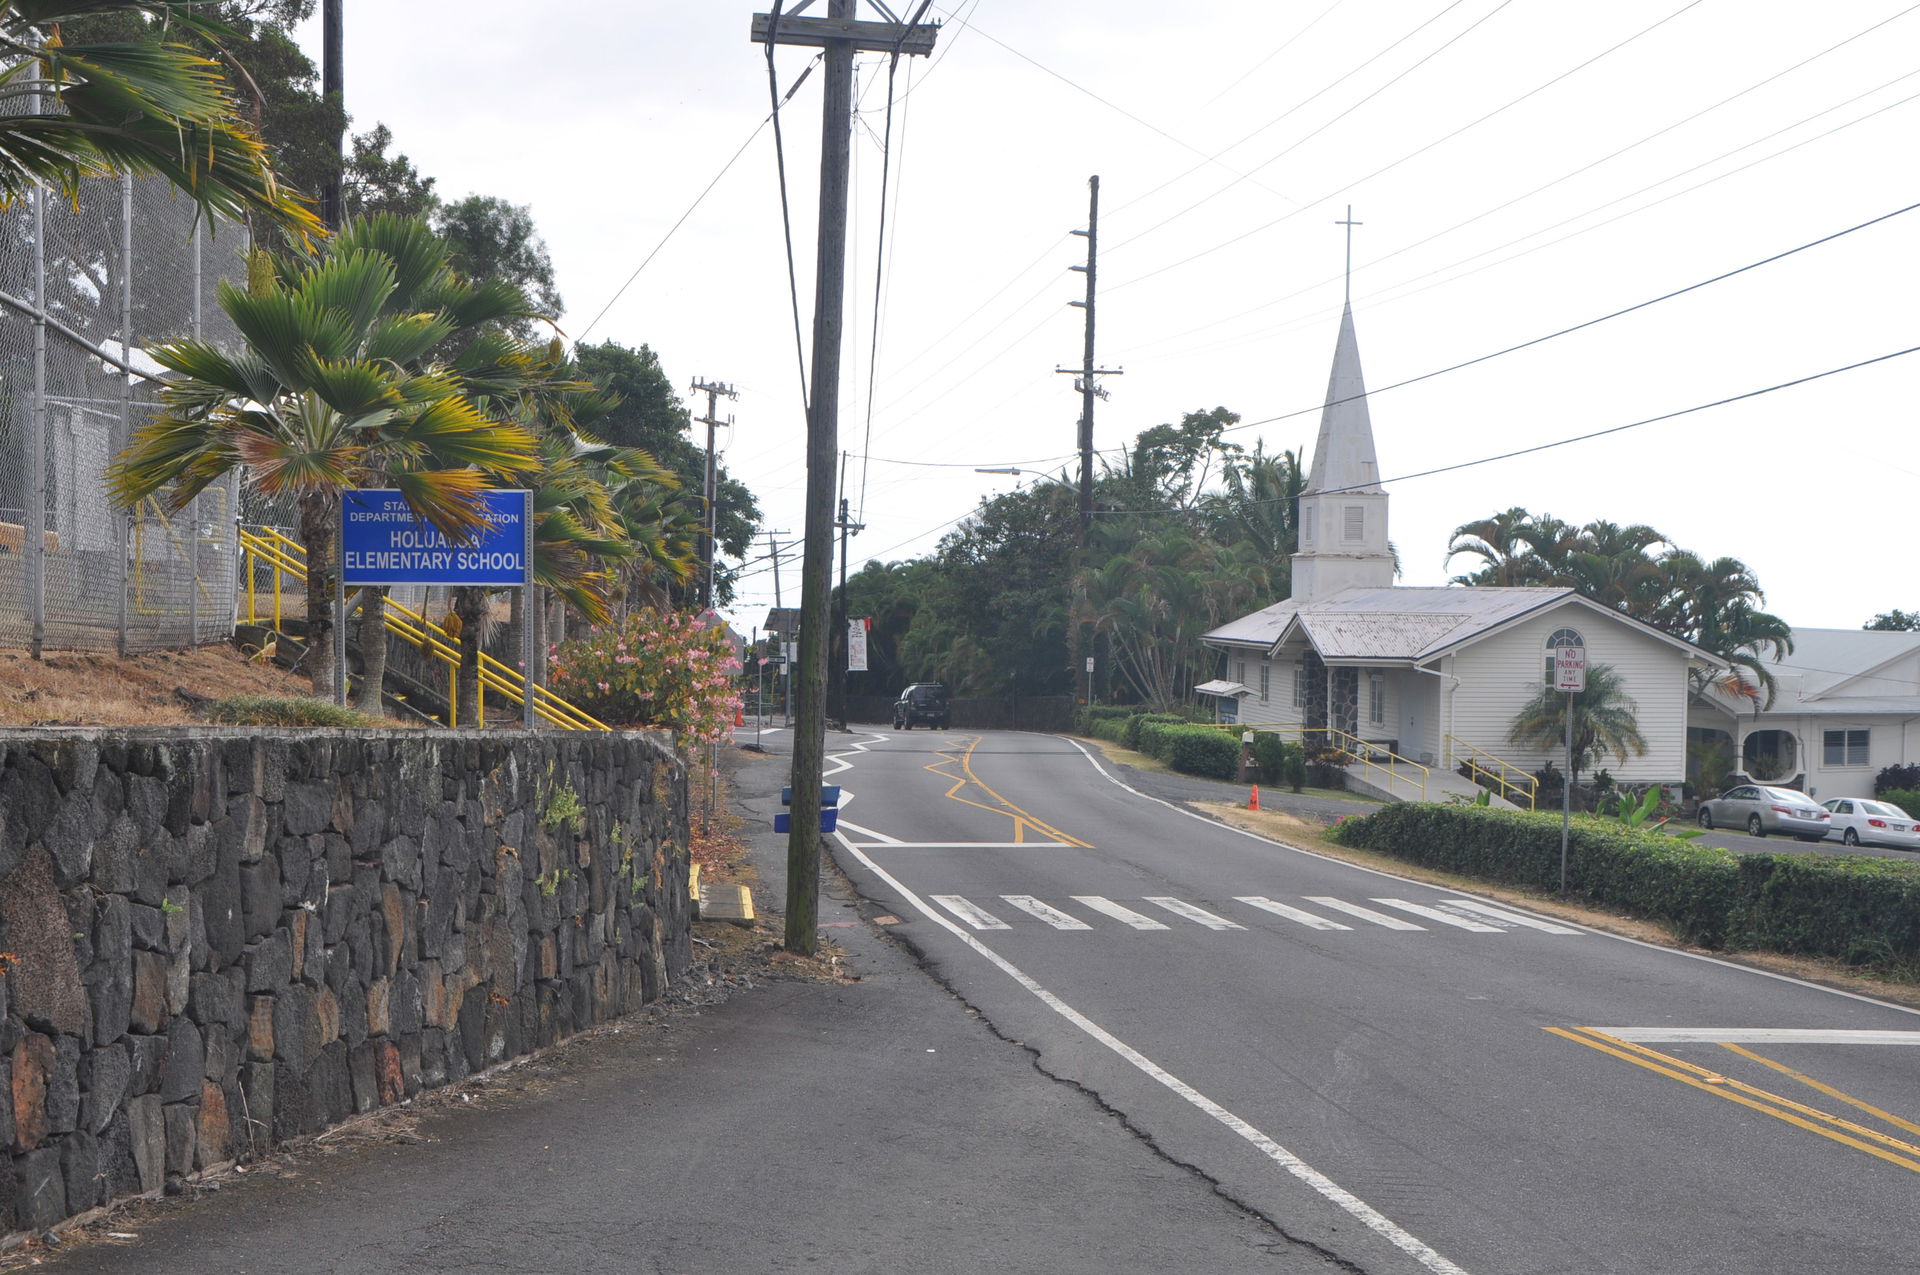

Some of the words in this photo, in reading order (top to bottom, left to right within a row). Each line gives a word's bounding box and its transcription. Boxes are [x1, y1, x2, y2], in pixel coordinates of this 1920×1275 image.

[350, 512, 428, 522] DEPARTME
[390, 530, 480, 549] HOLUAA
[345, 551, 453, 569] ELEMENTARY
[457, 552, 524, 570] SCHOOL
[1565, 649, 1576, 659] NO
[1557, 660, 1583, 669] PARKING
